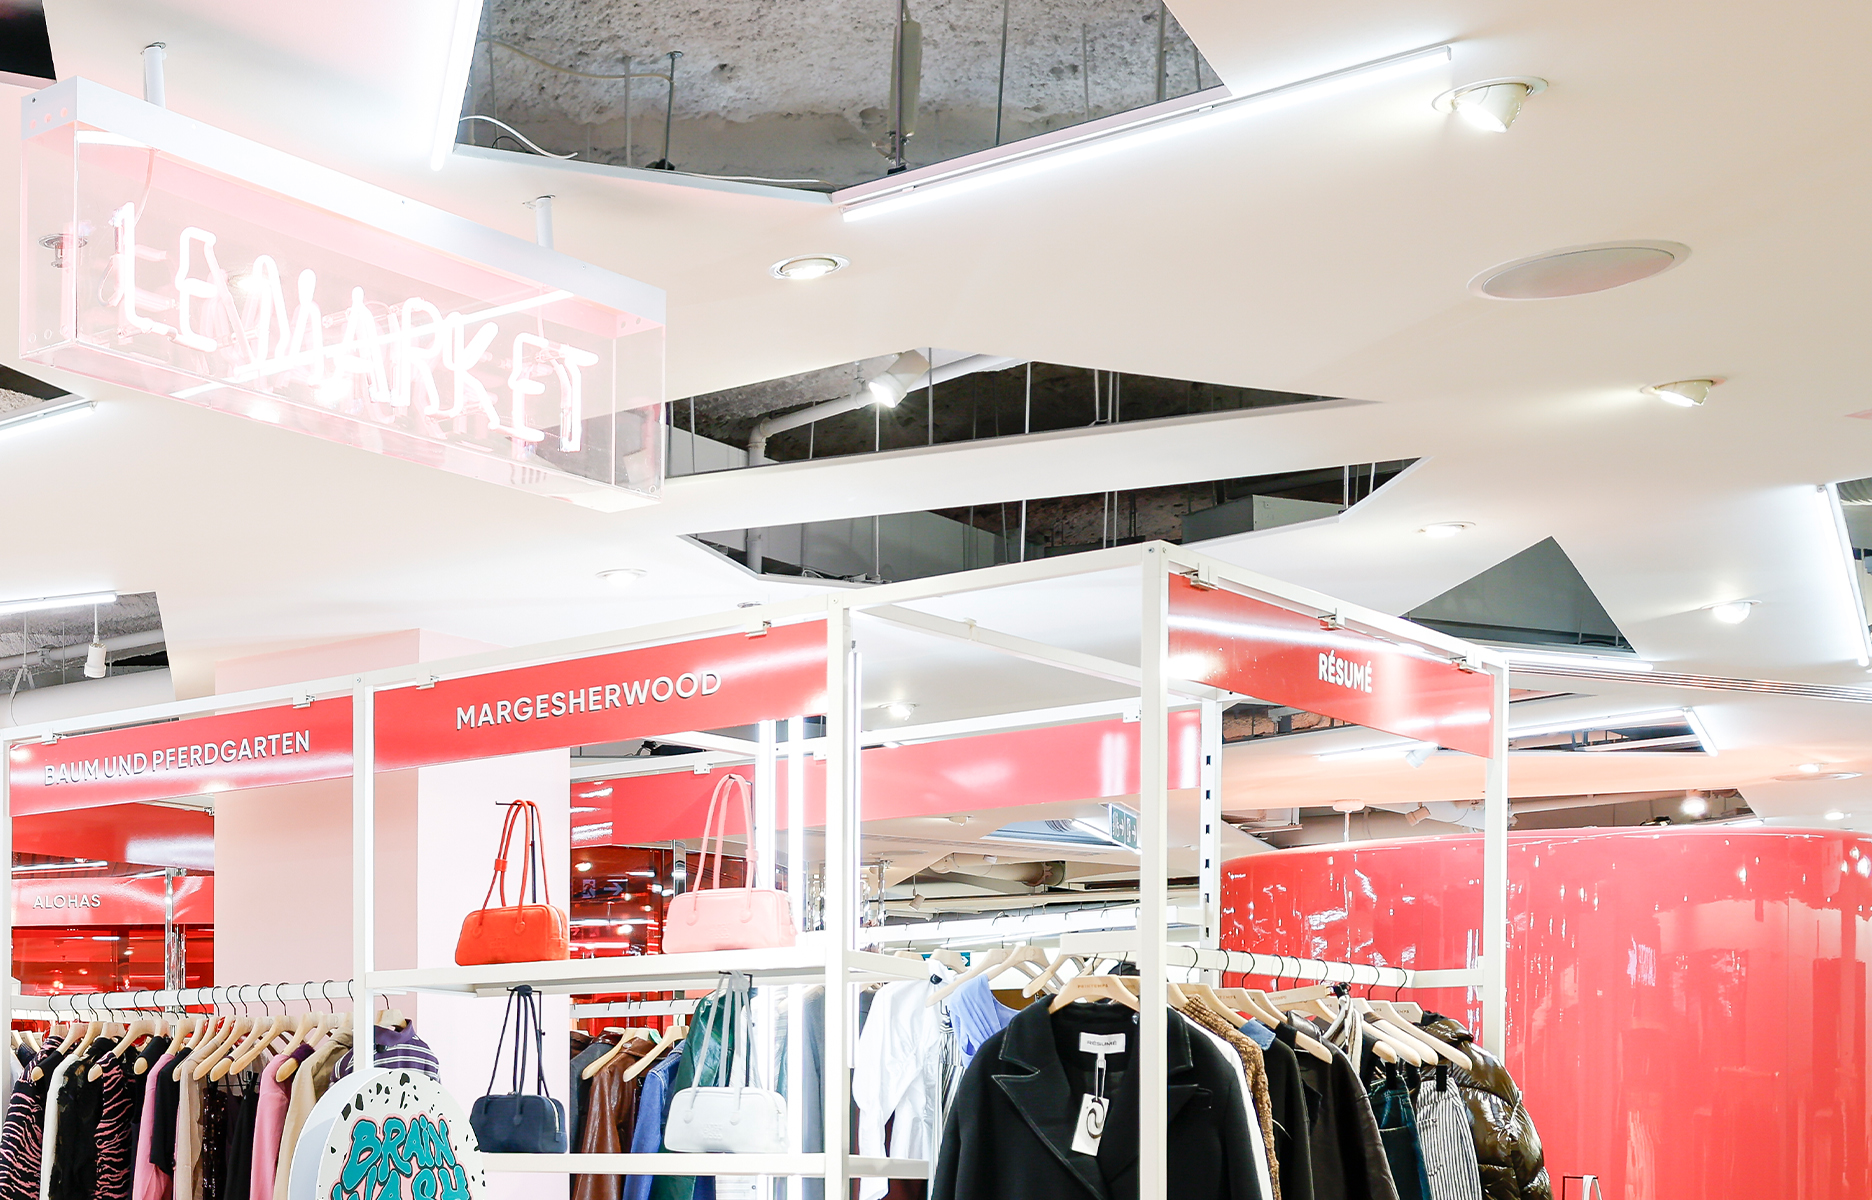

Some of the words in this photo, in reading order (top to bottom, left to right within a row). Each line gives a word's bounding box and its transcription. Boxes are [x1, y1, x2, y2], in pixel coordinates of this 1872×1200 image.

[234, 253, 600, 453] MARKET
[456, 669, 722, 730] MARGESHERWOOD
[1317, 649, 1373, 694] RÉSUMÉ
[44, 758, 99, 786] BAUM
[104, 753, 148, 778] UND
[152, 730, 311, 771] PFERDGARTEN
[32, 894, 101, 910] ALOHAS
